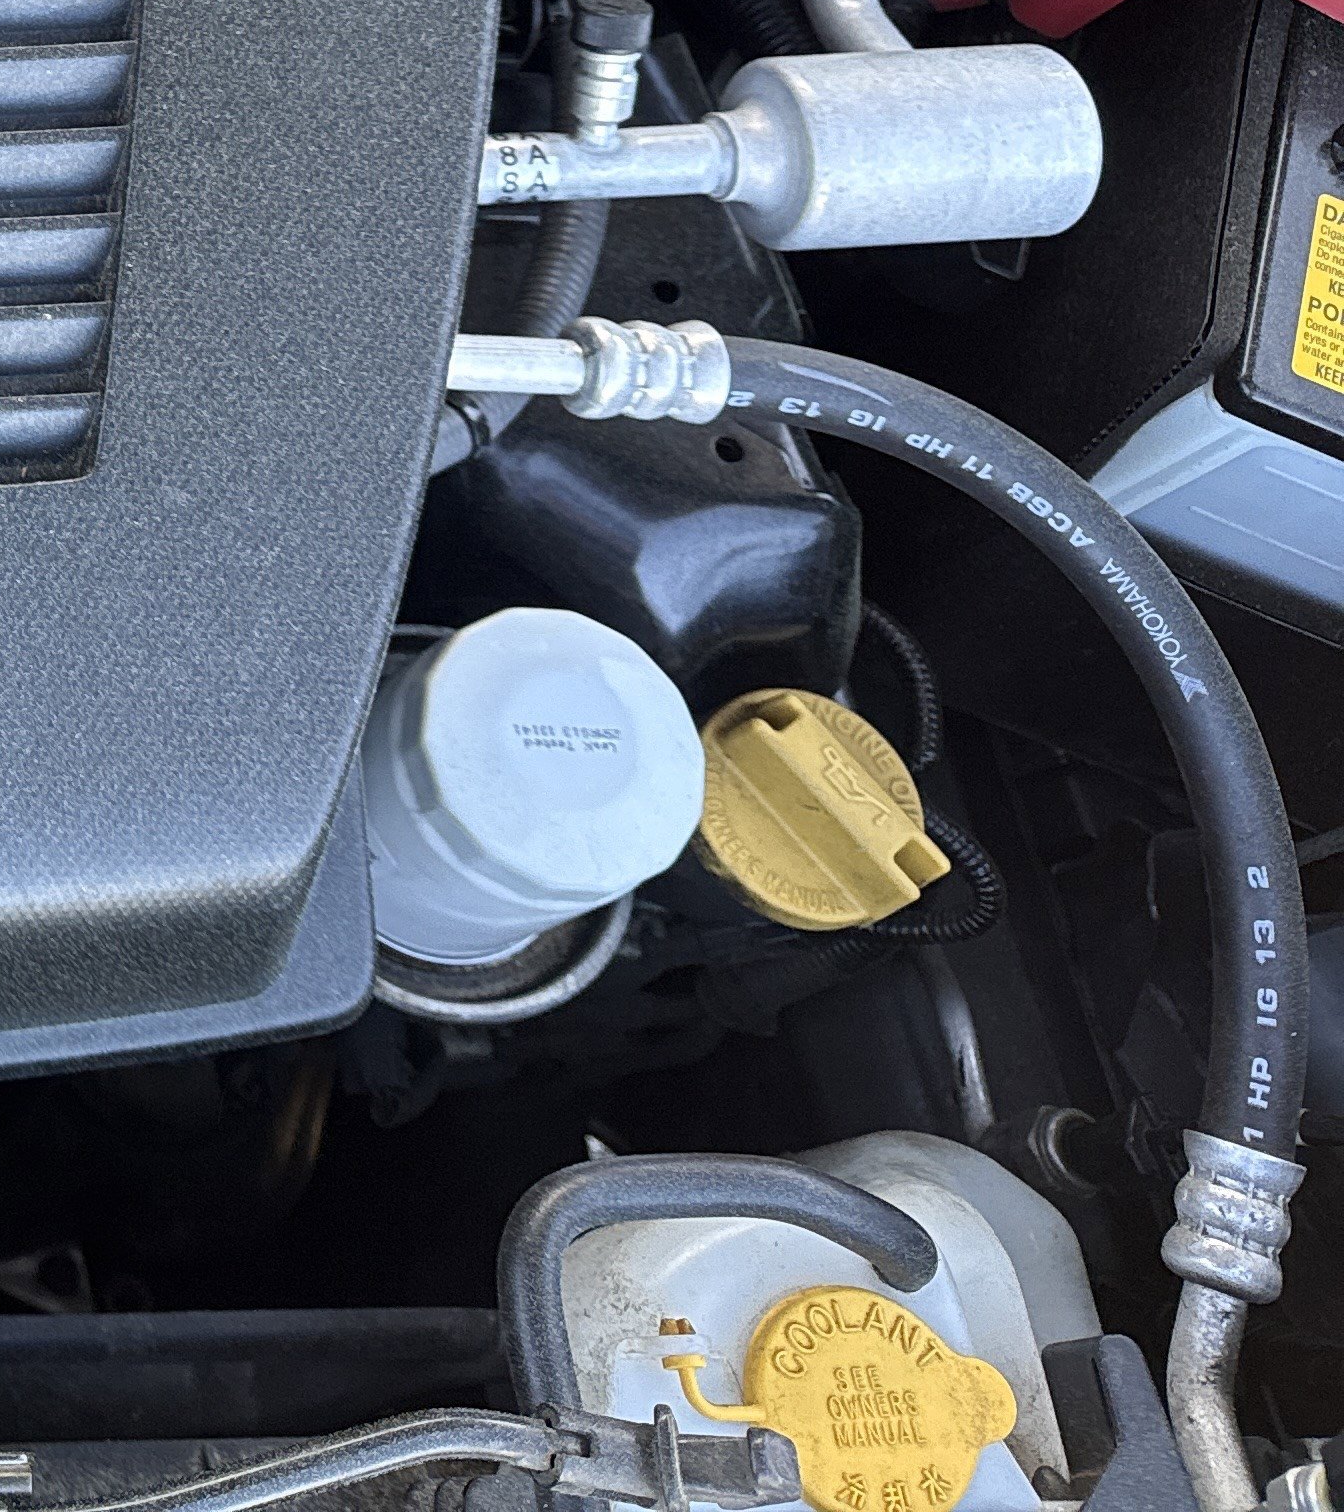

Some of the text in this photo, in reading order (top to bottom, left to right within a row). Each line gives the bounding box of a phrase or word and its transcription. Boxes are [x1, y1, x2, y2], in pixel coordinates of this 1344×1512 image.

[1316, 247, 1330, 262] Do
[1301, 342, 1333, 363] water
[1303, 331, 1339, 352] eyes or
[726, 389, 756, 407] 2
[777, 397, 823, 418] 13
[905, 432, 955, 459] HP
[961, 454, 994, 481] 11
[1006, 481, 1096, 548] AC6B
[1099, 557, 1188, 669] YOKOHAMA
[1246, 865, 1270, 889] 2
[1253, 919, 1276, 965] 13
[1247, 1056, 1273, 1110] HP
[772, 1299, 944, 1379] COOLANT
[833, 1364, 883, 1393] SEE
[826, 1389, 920, 1421] OWNERS
[832, 1419, 927, 1449] MANUAL
